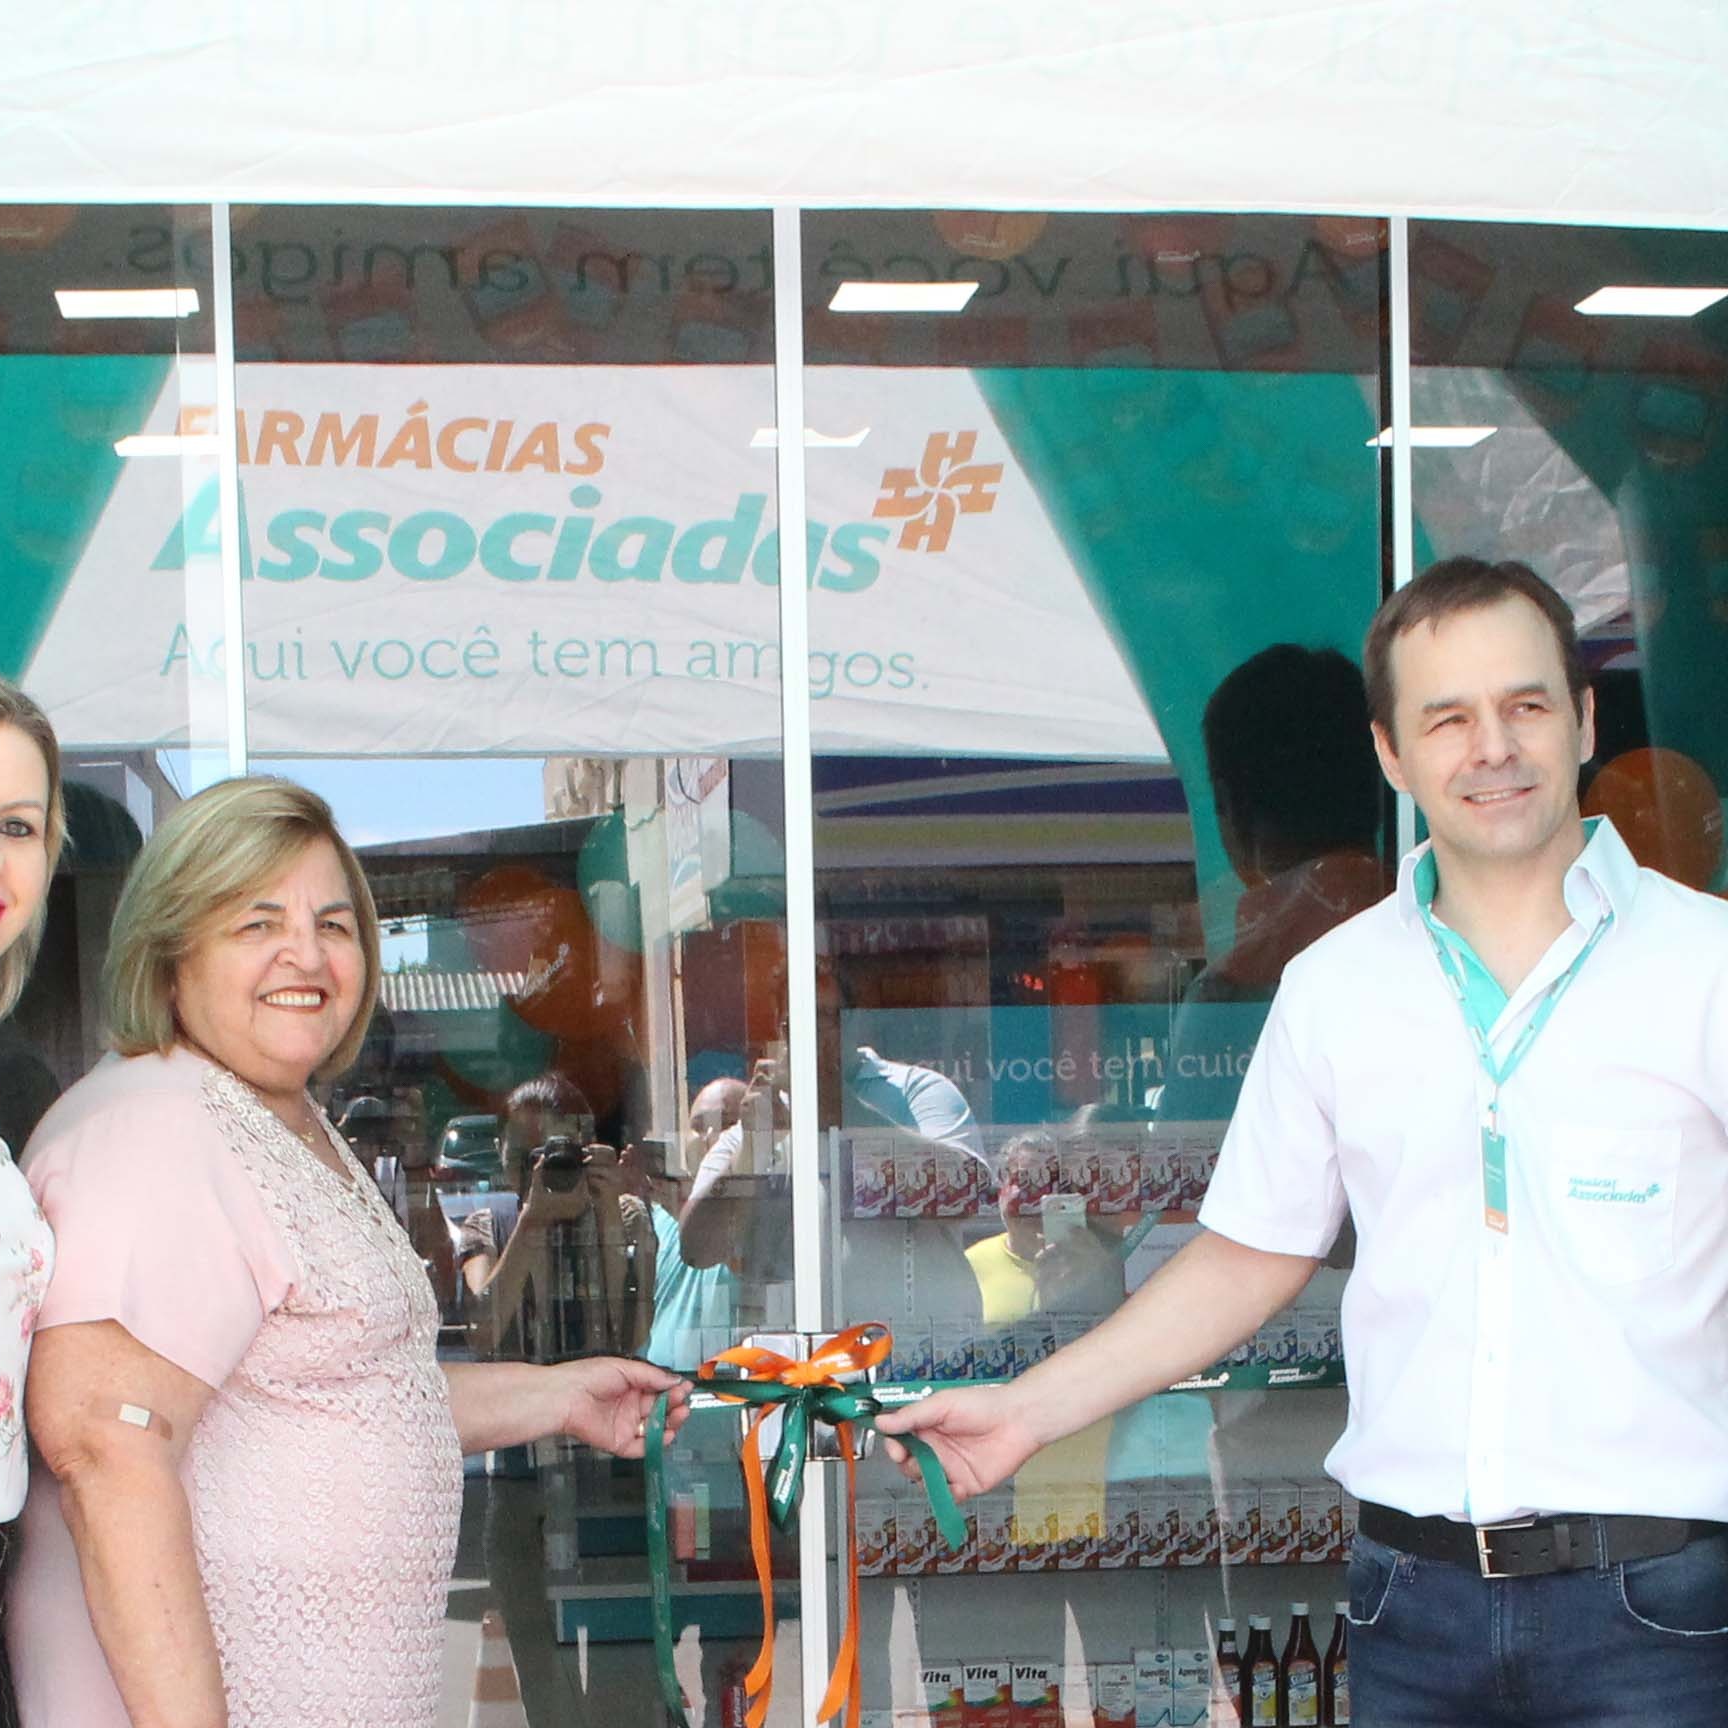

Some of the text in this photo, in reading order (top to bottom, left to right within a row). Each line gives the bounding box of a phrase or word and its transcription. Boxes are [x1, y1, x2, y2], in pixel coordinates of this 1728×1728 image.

[330, 625, 502, 682] você
[527, 630, 664, 679] tem
[685, 637, 930, 699] amgos.
[985, 1051, 1078, 1082] você
[1089, 1048, 1166, 1081] tem
[965, 1667, 999, 1681] Vita
[1014, 1667, 1048, 1681] Vita
